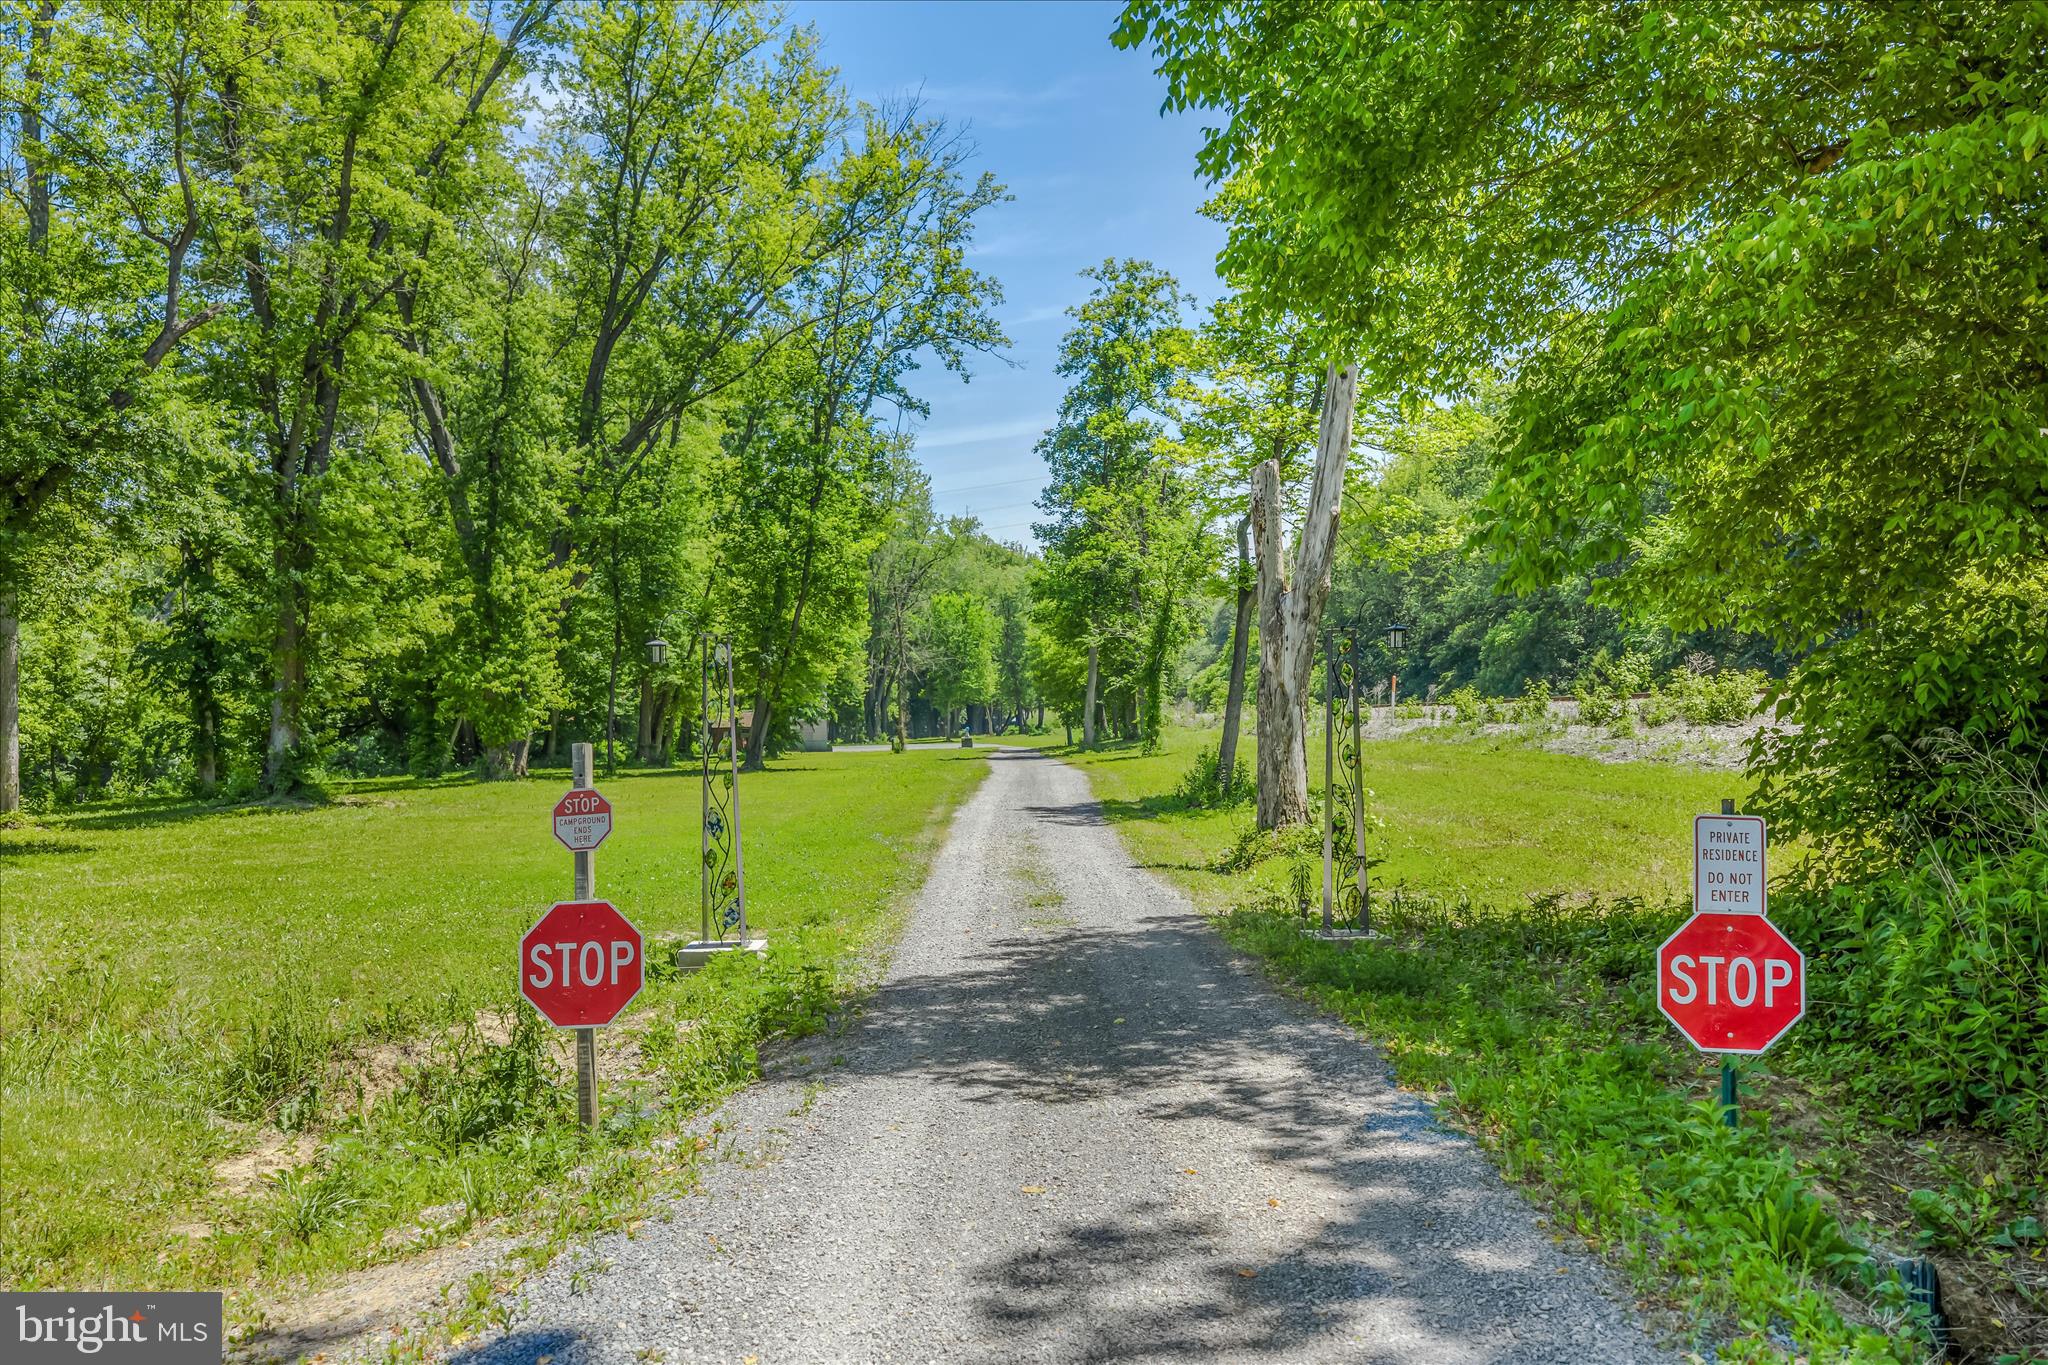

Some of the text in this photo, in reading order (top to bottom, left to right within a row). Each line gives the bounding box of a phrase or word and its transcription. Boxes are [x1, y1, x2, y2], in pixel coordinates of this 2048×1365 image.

[565, 797, 599, 813] STOP
[560, 816, 605, 826] CAMPGROUND
[574, 826, 592, 834] ENDS
[575, 835, 592, 843] HERE
[1710, 832, 1750, 844] PRIVATE
[1703, 849, 1758, 862] RESIDENCE
[1708, 872, 1752, 885] DO NOT
[1712, 890, 1749, 902] ENTER
[529, 941, 634, 988] STOP
[1669, 955, 1793, 1007] STOP
